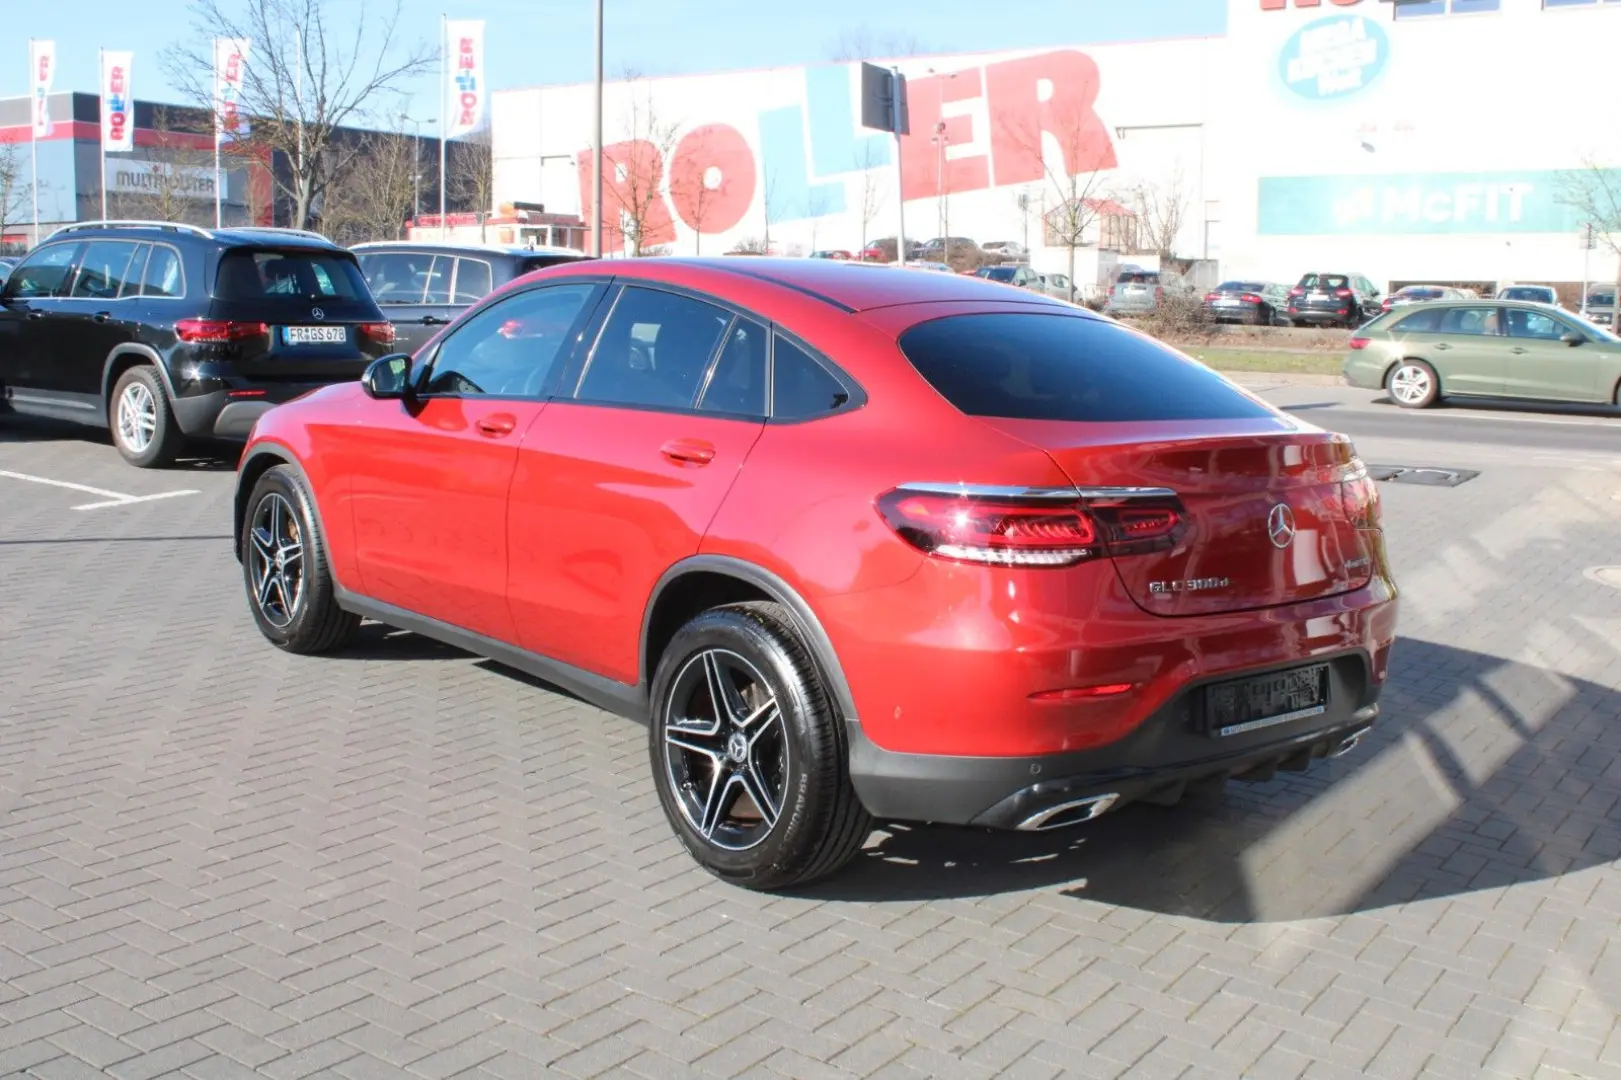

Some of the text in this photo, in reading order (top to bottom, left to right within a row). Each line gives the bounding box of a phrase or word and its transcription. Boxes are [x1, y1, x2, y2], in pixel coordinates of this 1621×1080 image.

[107, 66, 125, 140] ROLLER
[456, 38, 477, 125] ROLLER
[577, 49, 1117, 254] ROLLER
[1381, 182, 1534, 223] McFIT
[289, 328, 345, 340] FR GS 678
